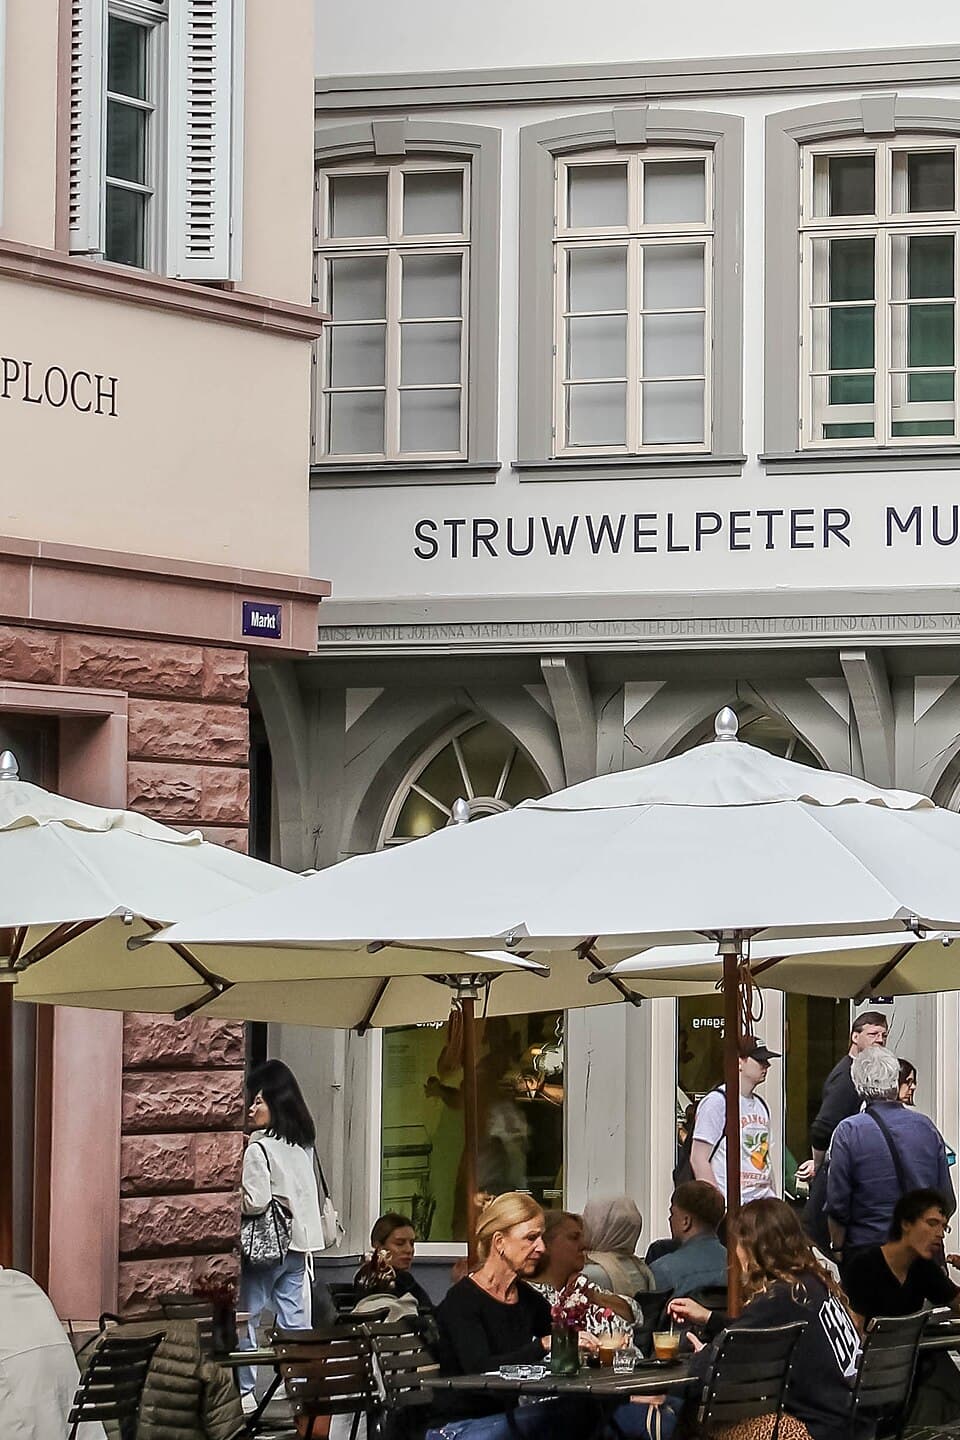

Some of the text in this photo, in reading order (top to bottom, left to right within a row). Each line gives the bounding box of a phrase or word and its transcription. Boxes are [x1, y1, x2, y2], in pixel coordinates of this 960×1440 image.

[0, 357, 119, 417] PLOCH
[413, 507, 851, 560] STRUWWELPETER
[251, 611, 276, 629] Markt
[319, 627, 352, 641] AUSE
[357, 626, 403, 640] WOHNTE
[407, 625, 465, 639] JOHANNA
[469, 624, 512, 638] MARIA
[564, 622, 583, 635] DIE
[589, 620, 665, 635] SCHWESTER
[670, 620, 695, 634] DER
[913, 615, 936, 629] DES
